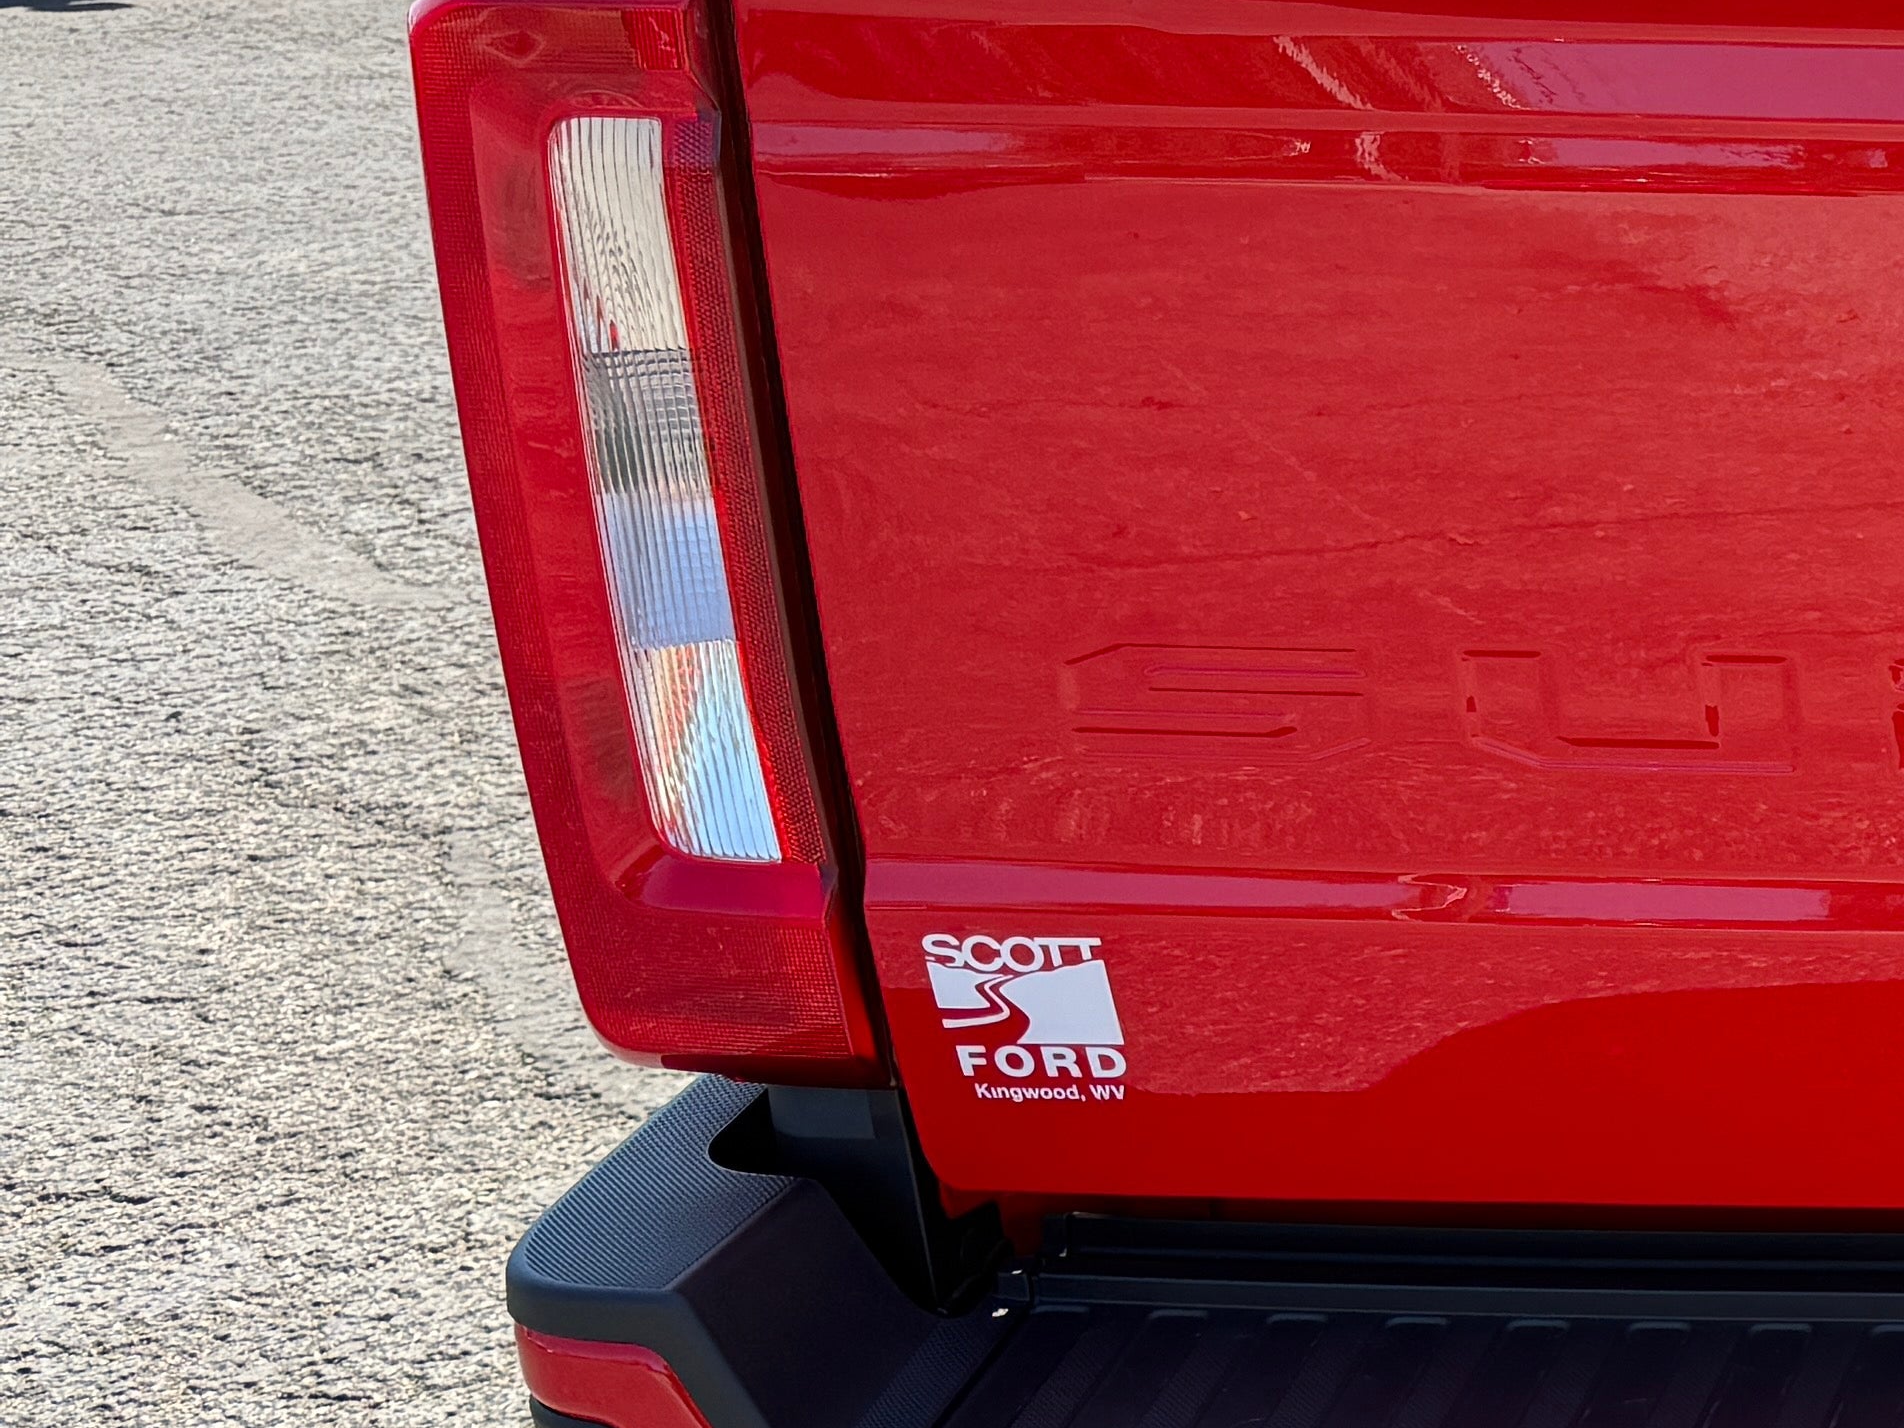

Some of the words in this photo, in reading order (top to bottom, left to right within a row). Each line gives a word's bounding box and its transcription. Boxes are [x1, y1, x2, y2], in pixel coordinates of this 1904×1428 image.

[921, 934, 1102, 973] SCOTT
[955, 1044, 1128, 1079] FORD
[974, 1082, 1087, 1103] Kingwood,
[1088, 1084, 1125, 1101] WV
